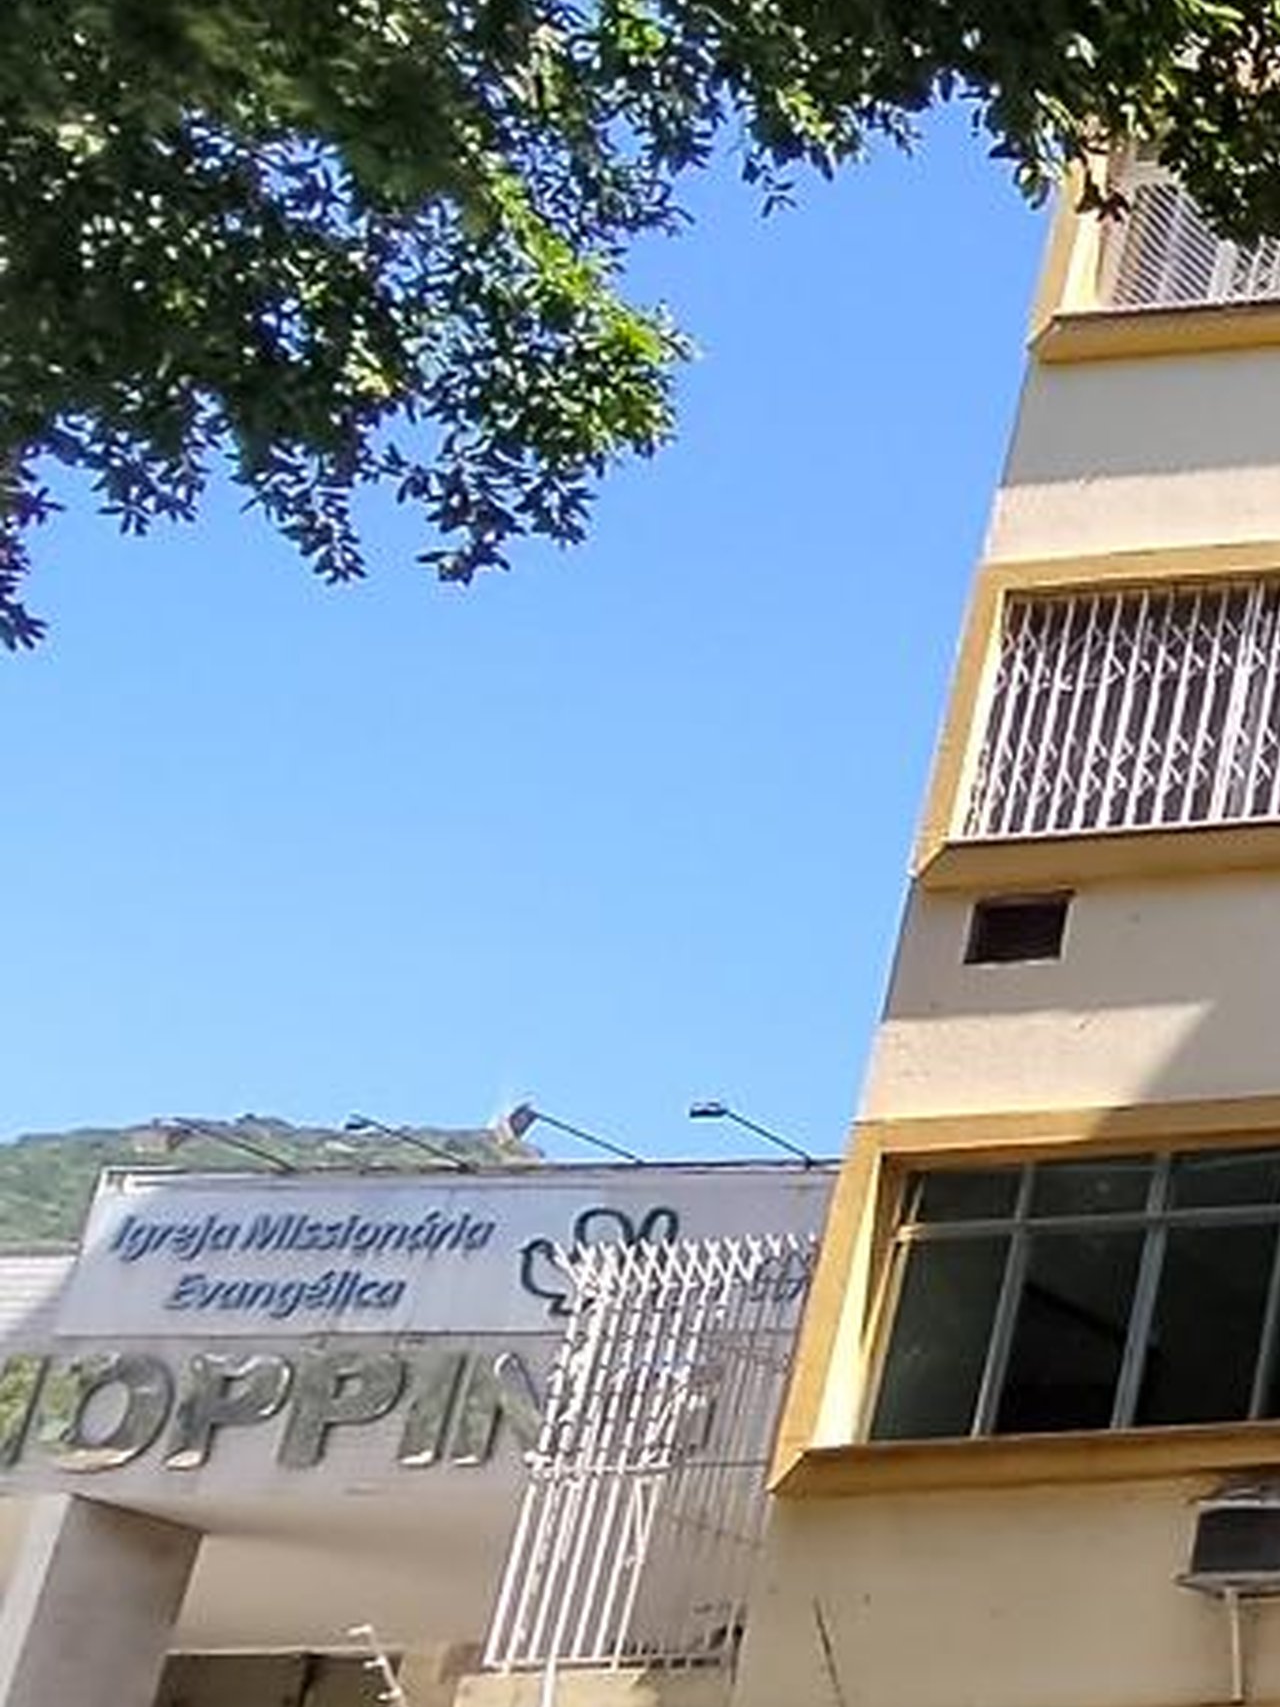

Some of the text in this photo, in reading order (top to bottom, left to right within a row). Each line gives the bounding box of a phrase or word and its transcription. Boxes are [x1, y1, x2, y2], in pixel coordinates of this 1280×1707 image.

[109, 1209, 497, 1262] Igreja Missionária
[162, 1268, 407, 1320] Evangélica
